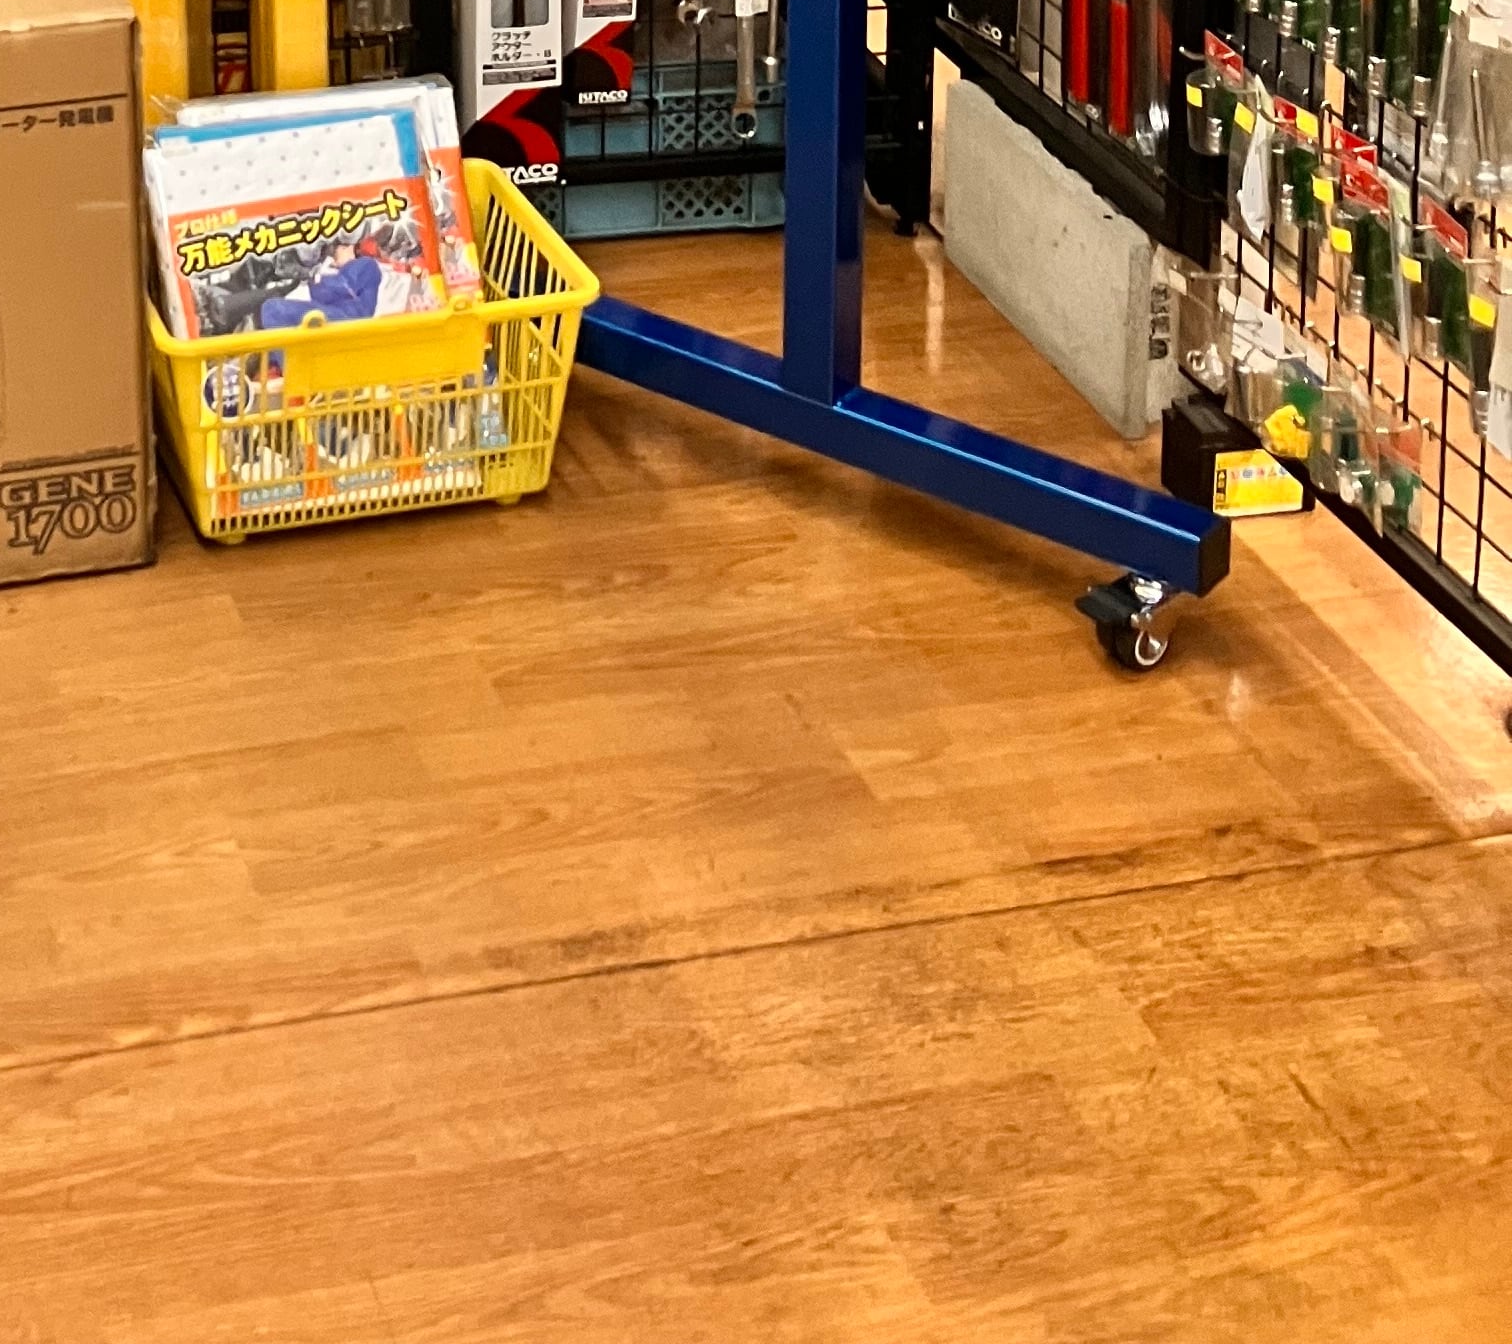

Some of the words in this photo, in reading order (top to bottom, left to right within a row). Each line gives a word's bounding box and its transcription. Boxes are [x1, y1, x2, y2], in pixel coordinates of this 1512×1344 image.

[501, 162, 559, 185] TACO
[178, 189, 408, 277] 万能メカニックシート
[7, 492, 138, 556] 1700
